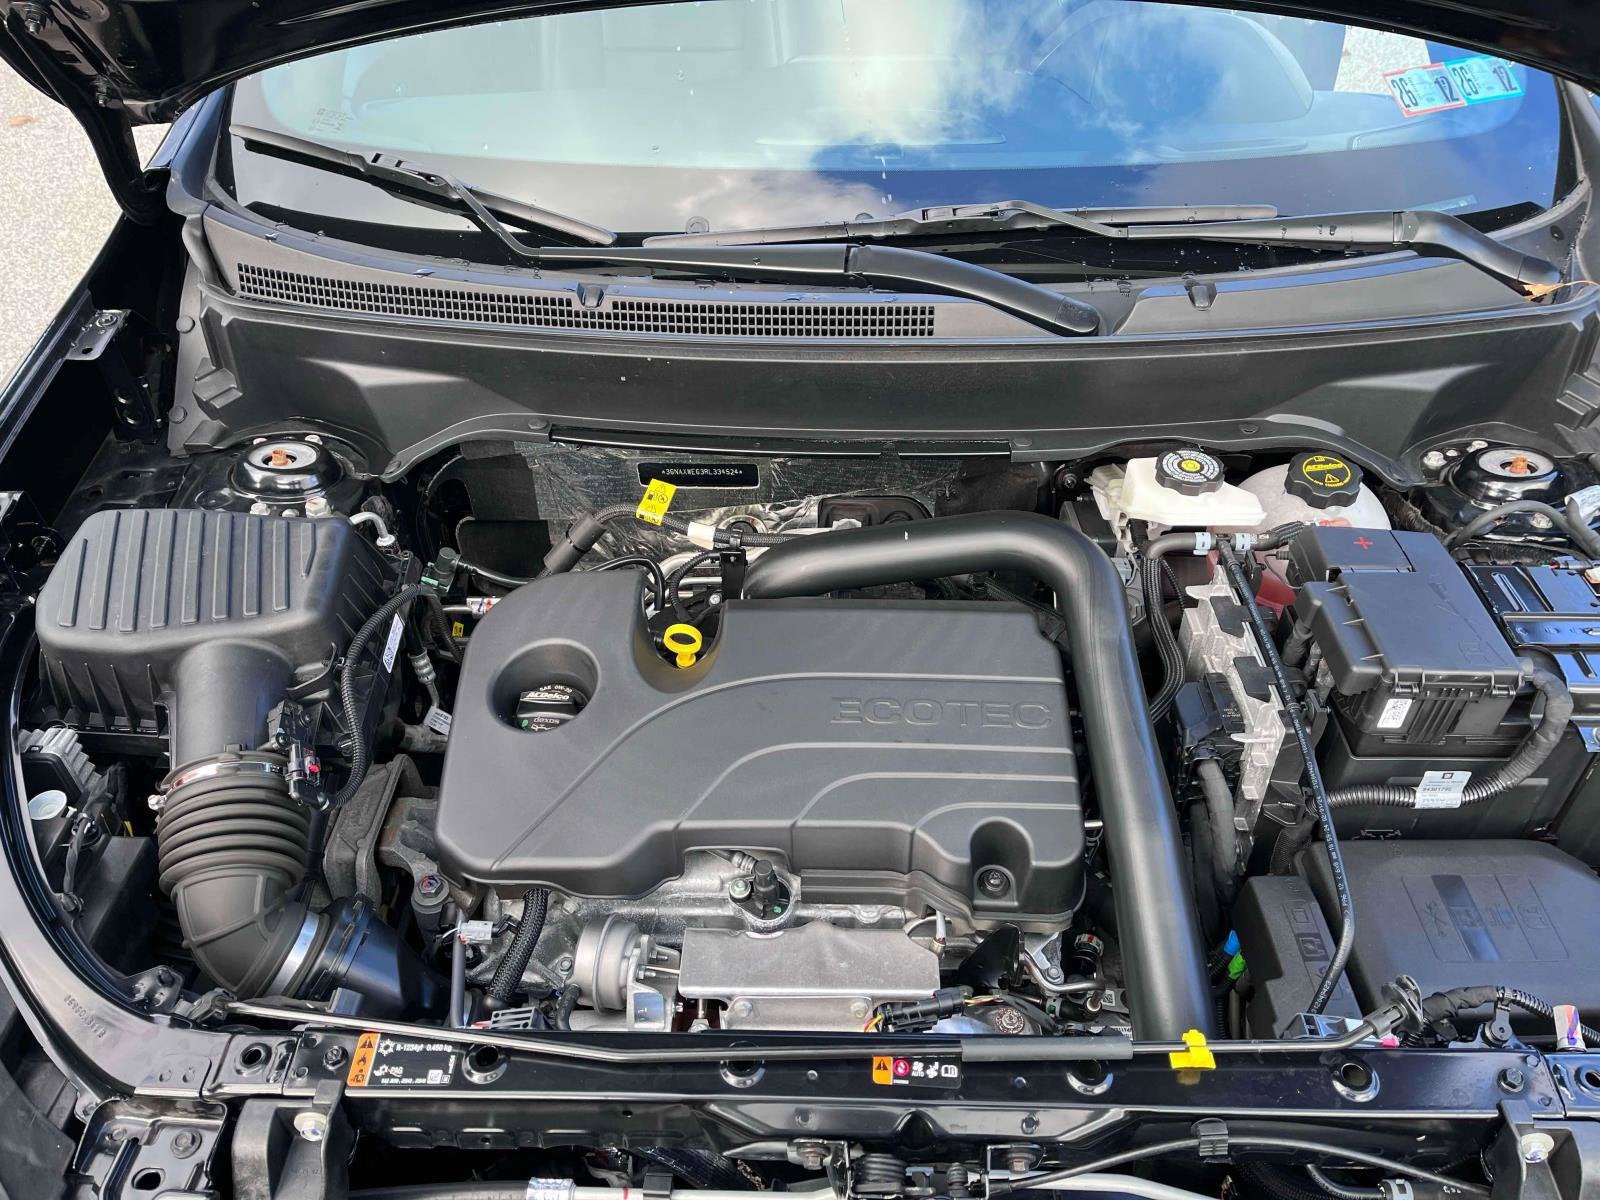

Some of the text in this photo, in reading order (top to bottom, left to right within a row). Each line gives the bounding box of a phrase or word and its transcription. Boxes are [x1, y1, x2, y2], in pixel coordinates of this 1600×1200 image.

[1390, 75, 1460, 109] 26 12
[1452, 65, 1518, 97] 26 12
[526, 691, 570, 700] ACDelco
[830, 697, 1052, 729] ECOTEC
[396, 1043, 424, 1052] R-1234yf
